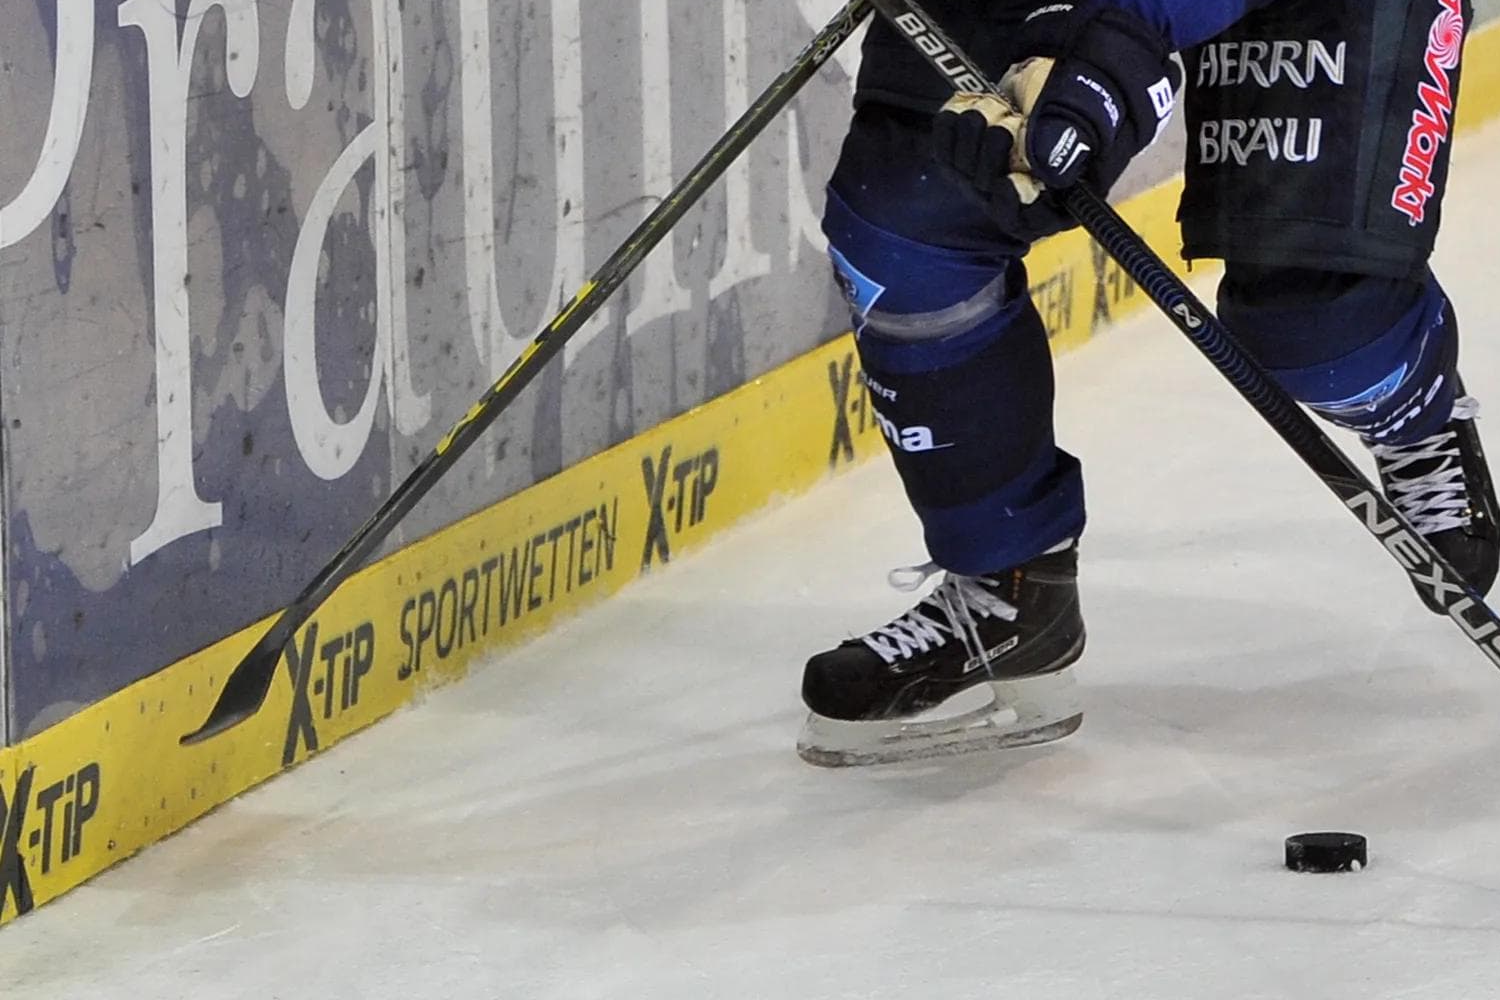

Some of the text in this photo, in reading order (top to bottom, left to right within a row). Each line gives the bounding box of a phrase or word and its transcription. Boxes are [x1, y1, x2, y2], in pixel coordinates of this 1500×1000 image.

[895, 12, 985, 93] BAUE
[1196, 40, 1347, 89] HERRN
[1200, 117, 1322, 166] BRÄU
[398, 497, 620, 680] SPORTWETTEN
